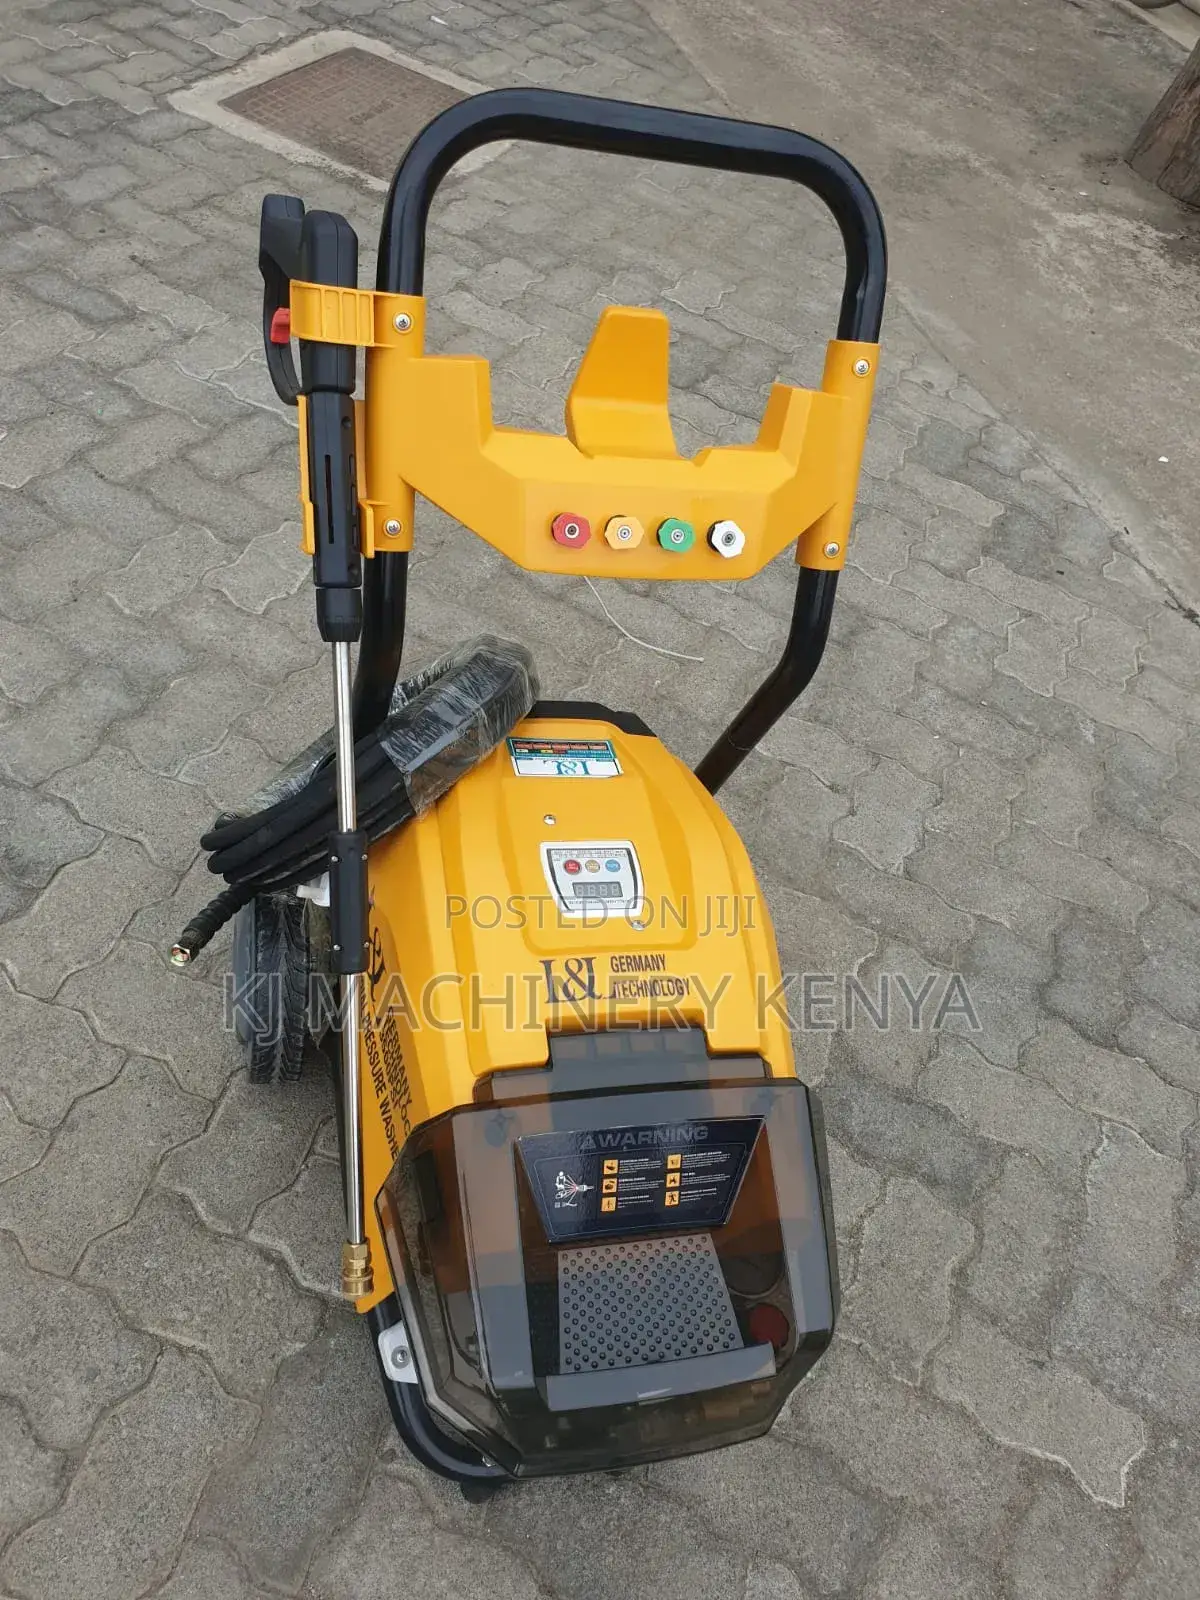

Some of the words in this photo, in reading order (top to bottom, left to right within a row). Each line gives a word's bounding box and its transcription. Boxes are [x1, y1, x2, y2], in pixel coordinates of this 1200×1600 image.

[610, 953, 666, 974] GERMANY
[614, 978, 690, 998] TECHNOLOGY
[362, 1011, 387, 1099] PRESSURE
[379, 1094, 400, 1162] WASHE
[599, 1126, 709, 1147] WARNING
